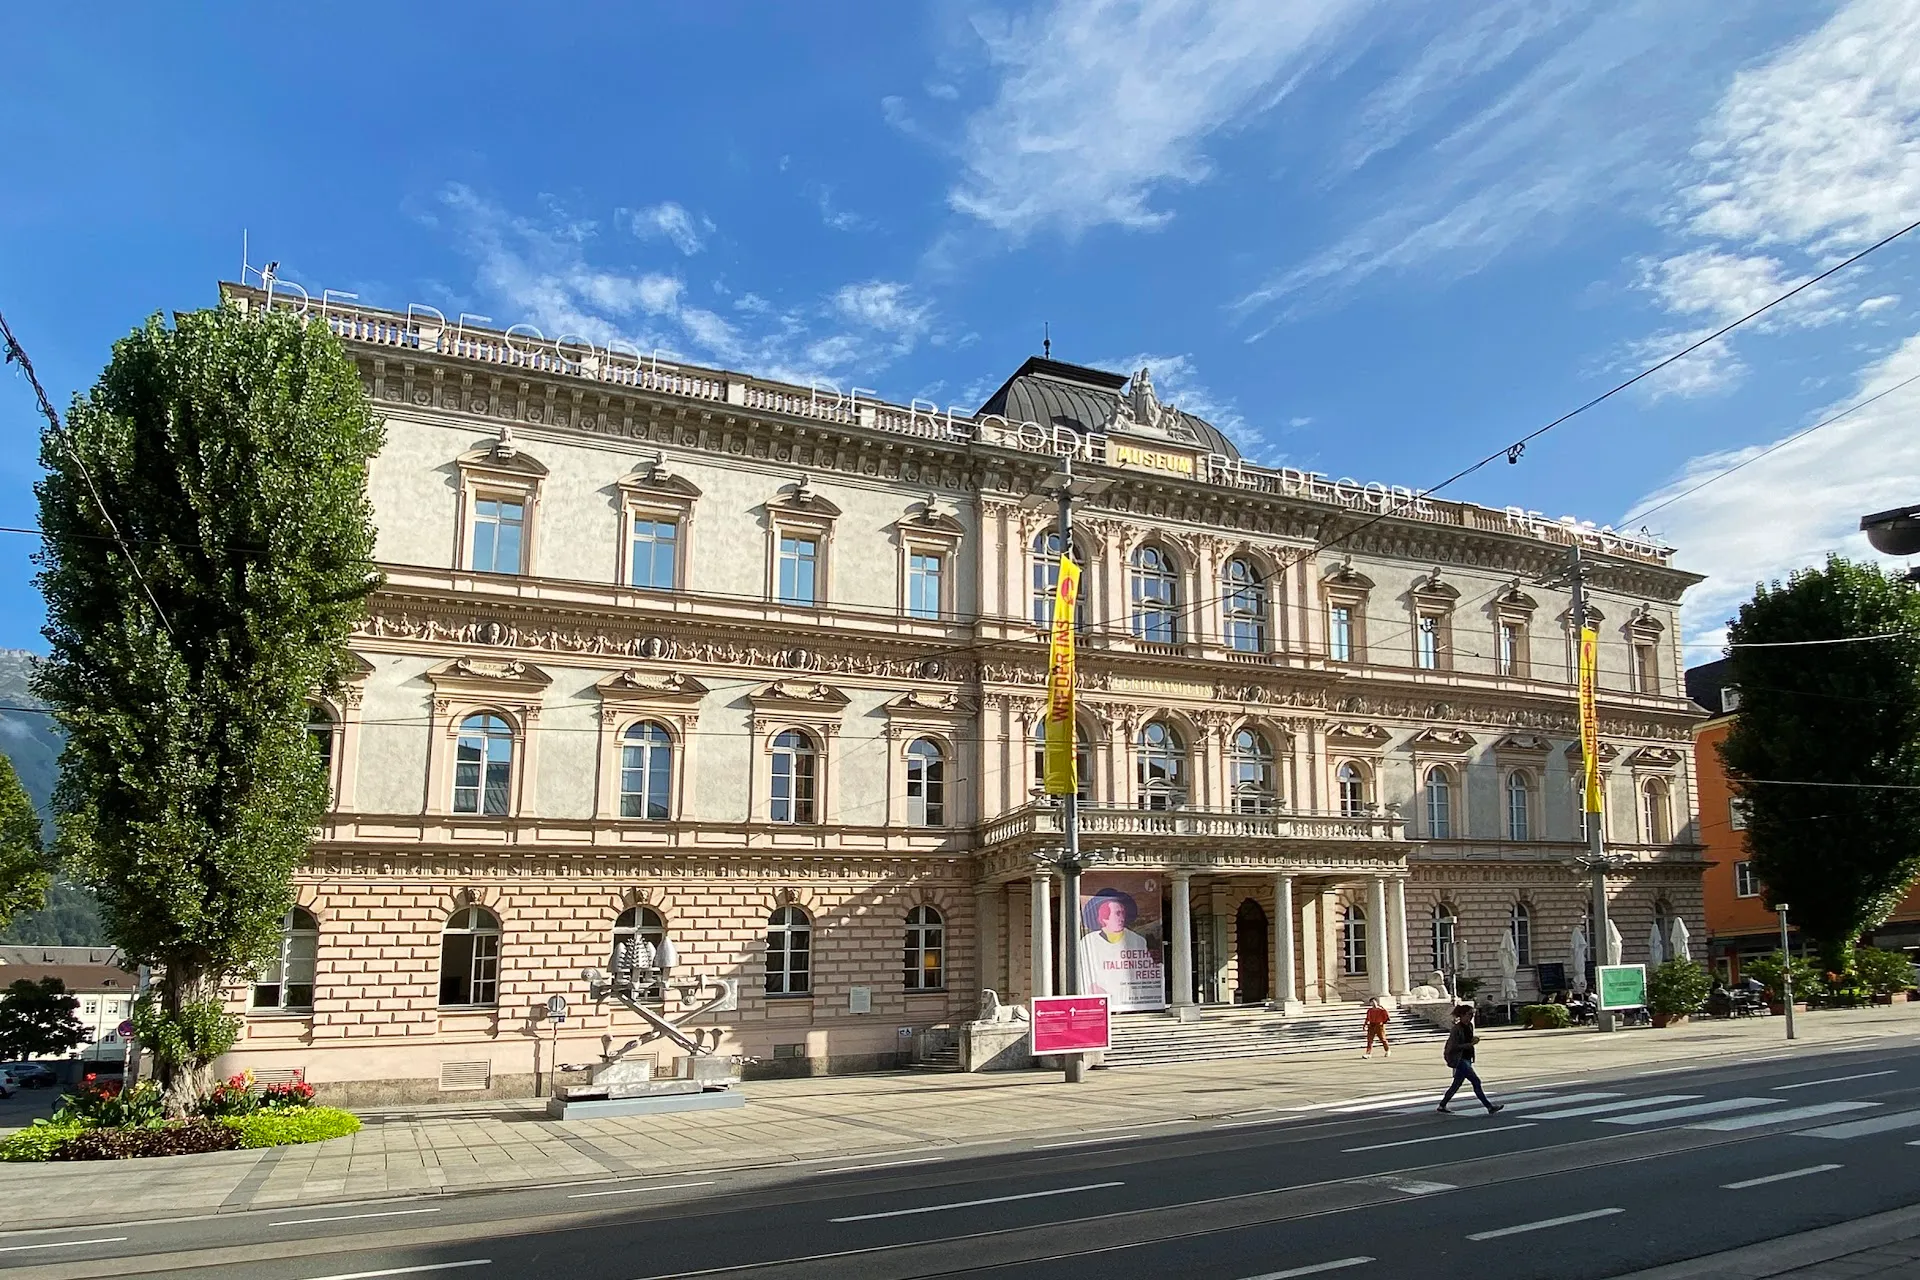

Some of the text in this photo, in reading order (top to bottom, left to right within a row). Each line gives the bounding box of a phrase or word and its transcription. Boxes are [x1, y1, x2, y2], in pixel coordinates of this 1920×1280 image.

[911, 397, 1109, 461] RECODE
[1208, 453, 1258, 485] RE
[1282, 467, 1434, 515] DECODE
[1505, 506, 1546, 535] RE
[1117, 446, 1193, 474] MUSEUM
[1051, 620, 1071, 722] WIEDER INS
[1103, 960, 1161, 970] ITALIENISCHE
[1136, 970, 1161, 979] REISE
